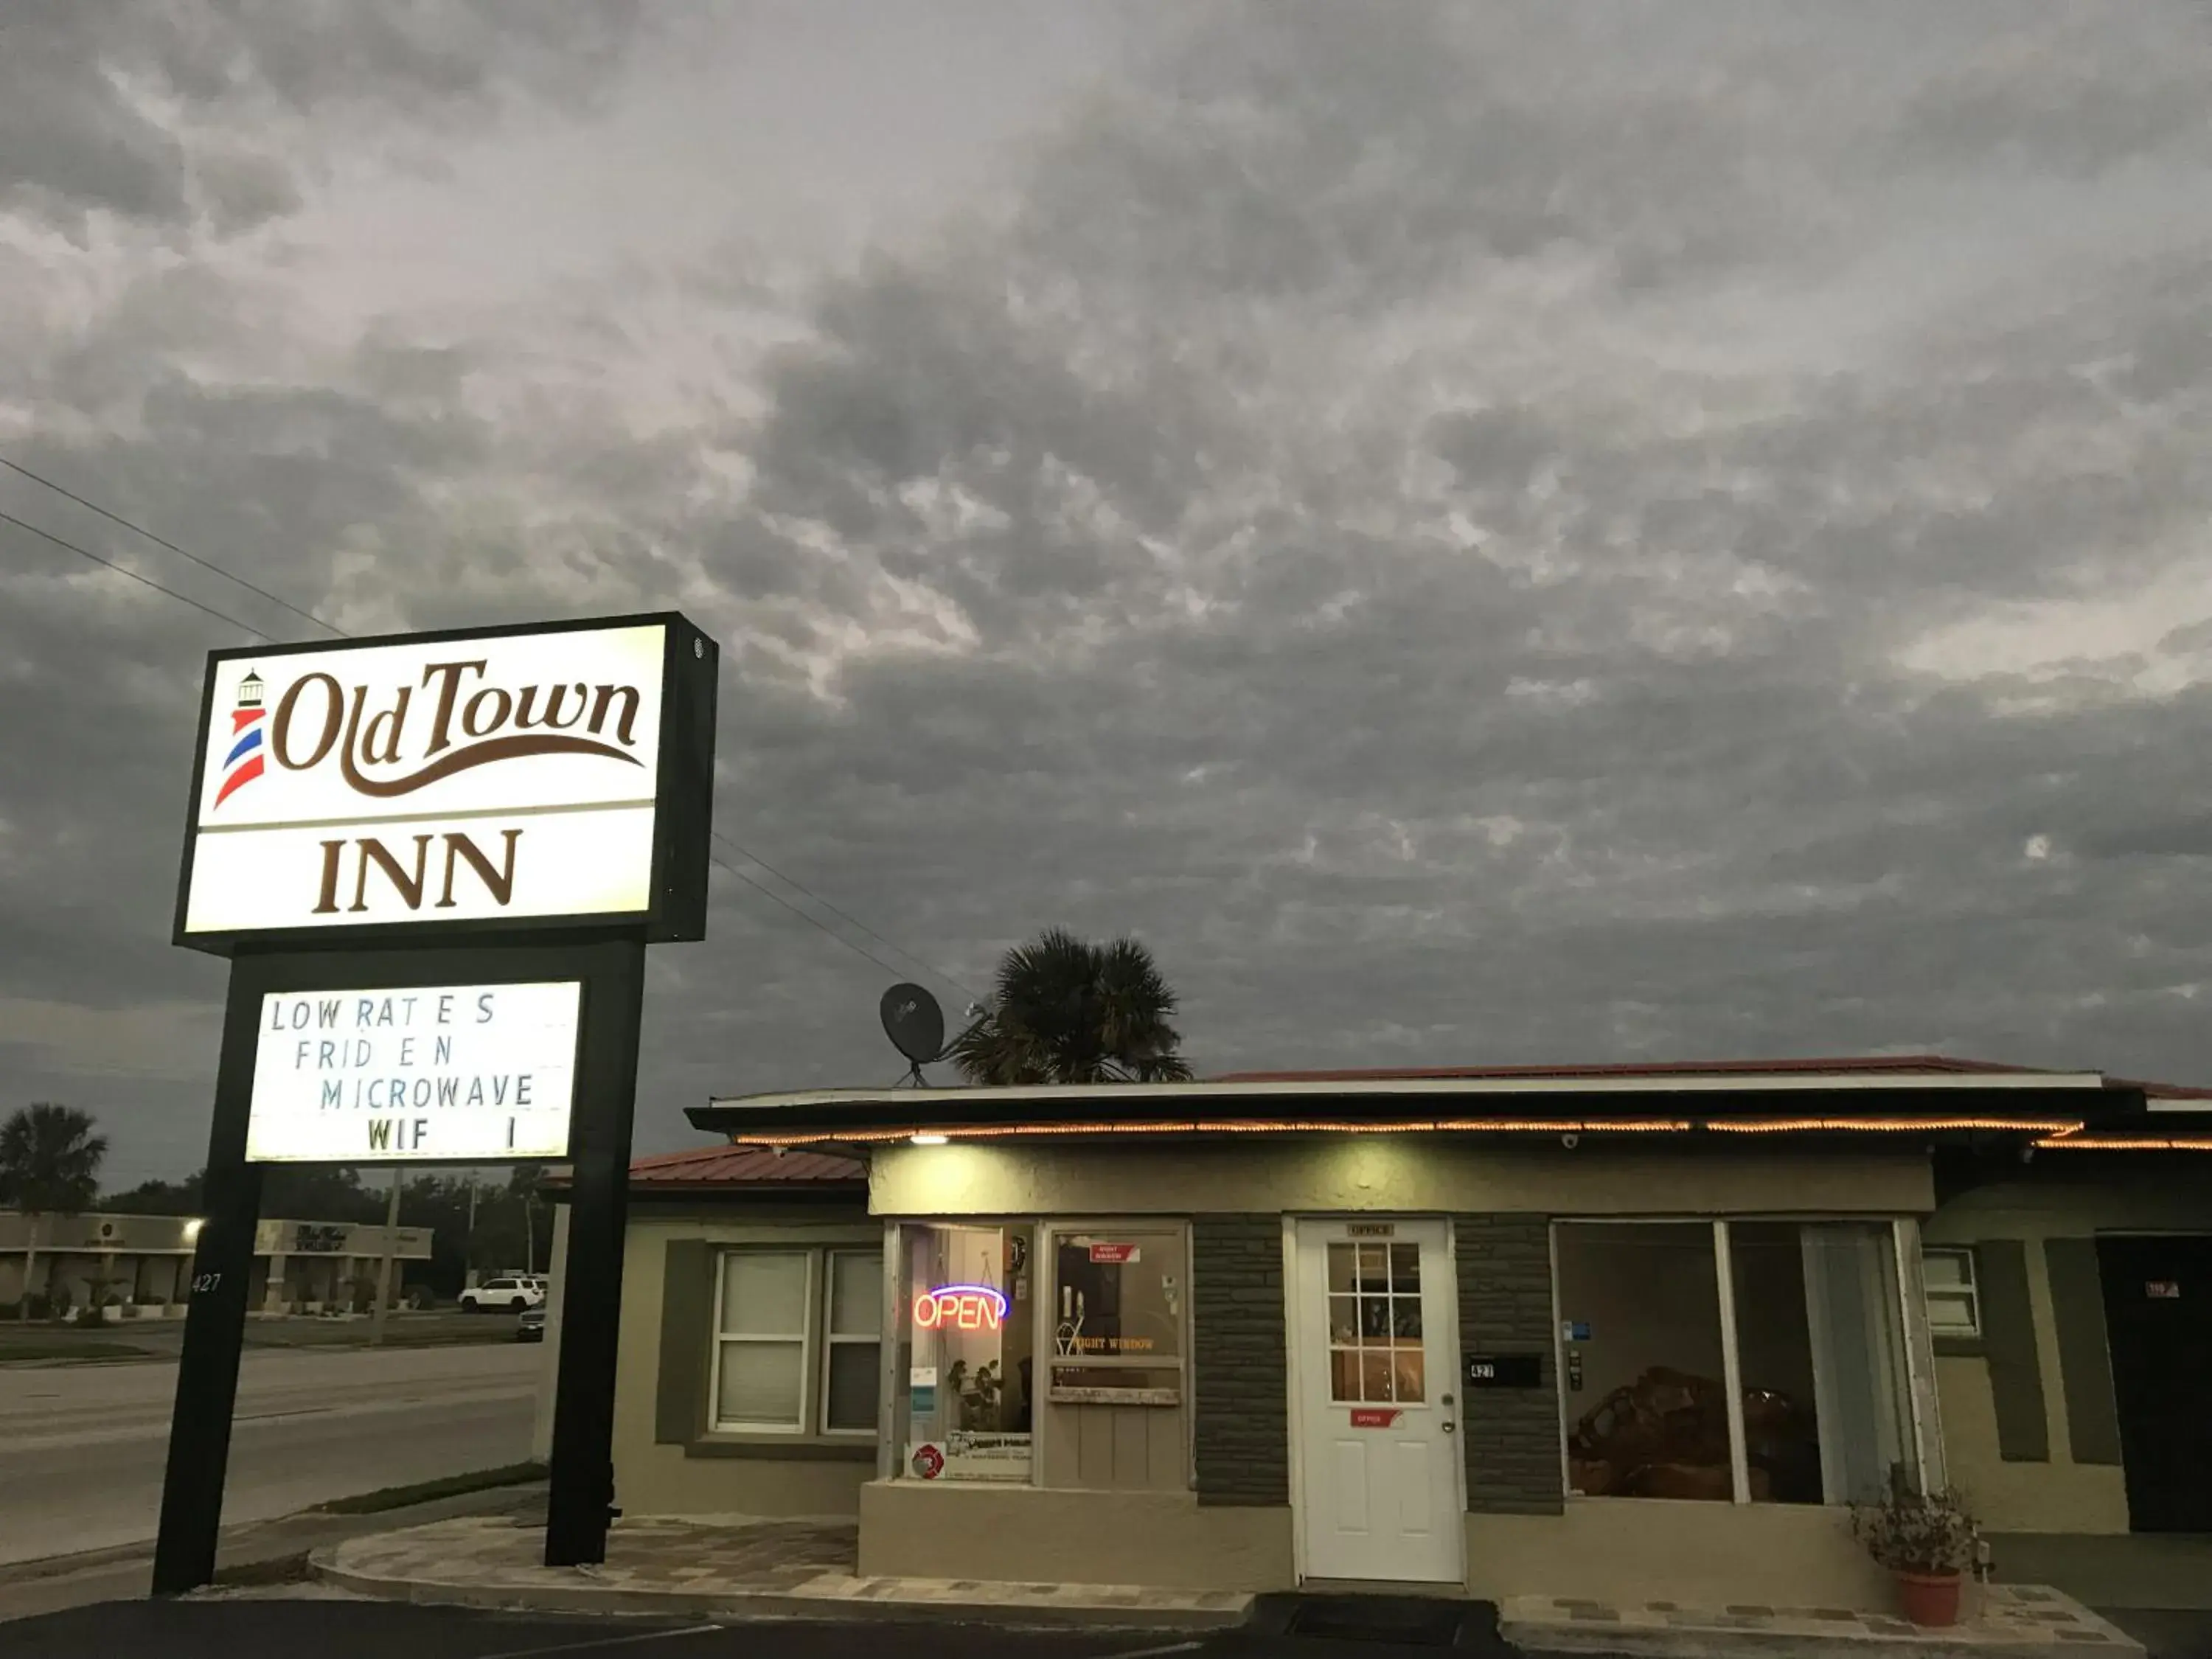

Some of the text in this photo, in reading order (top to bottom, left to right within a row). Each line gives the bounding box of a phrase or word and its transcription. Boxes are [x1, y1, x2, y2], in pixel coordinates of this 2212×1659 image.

[271, 658, 643, 797] Old Town
[312, 829, 524, 914] INN
[272, 999, 342, 1030] LOW
[320, 1074, 533, 1110] MICROWAVE
[1350, 1225, 1391, 1236] OFFICE
[192, 1273, 221, 1293] 427
[914, 1293, 1000, 1329] OPEN
[1109, 1337, 1155, 1351] WINDOW
